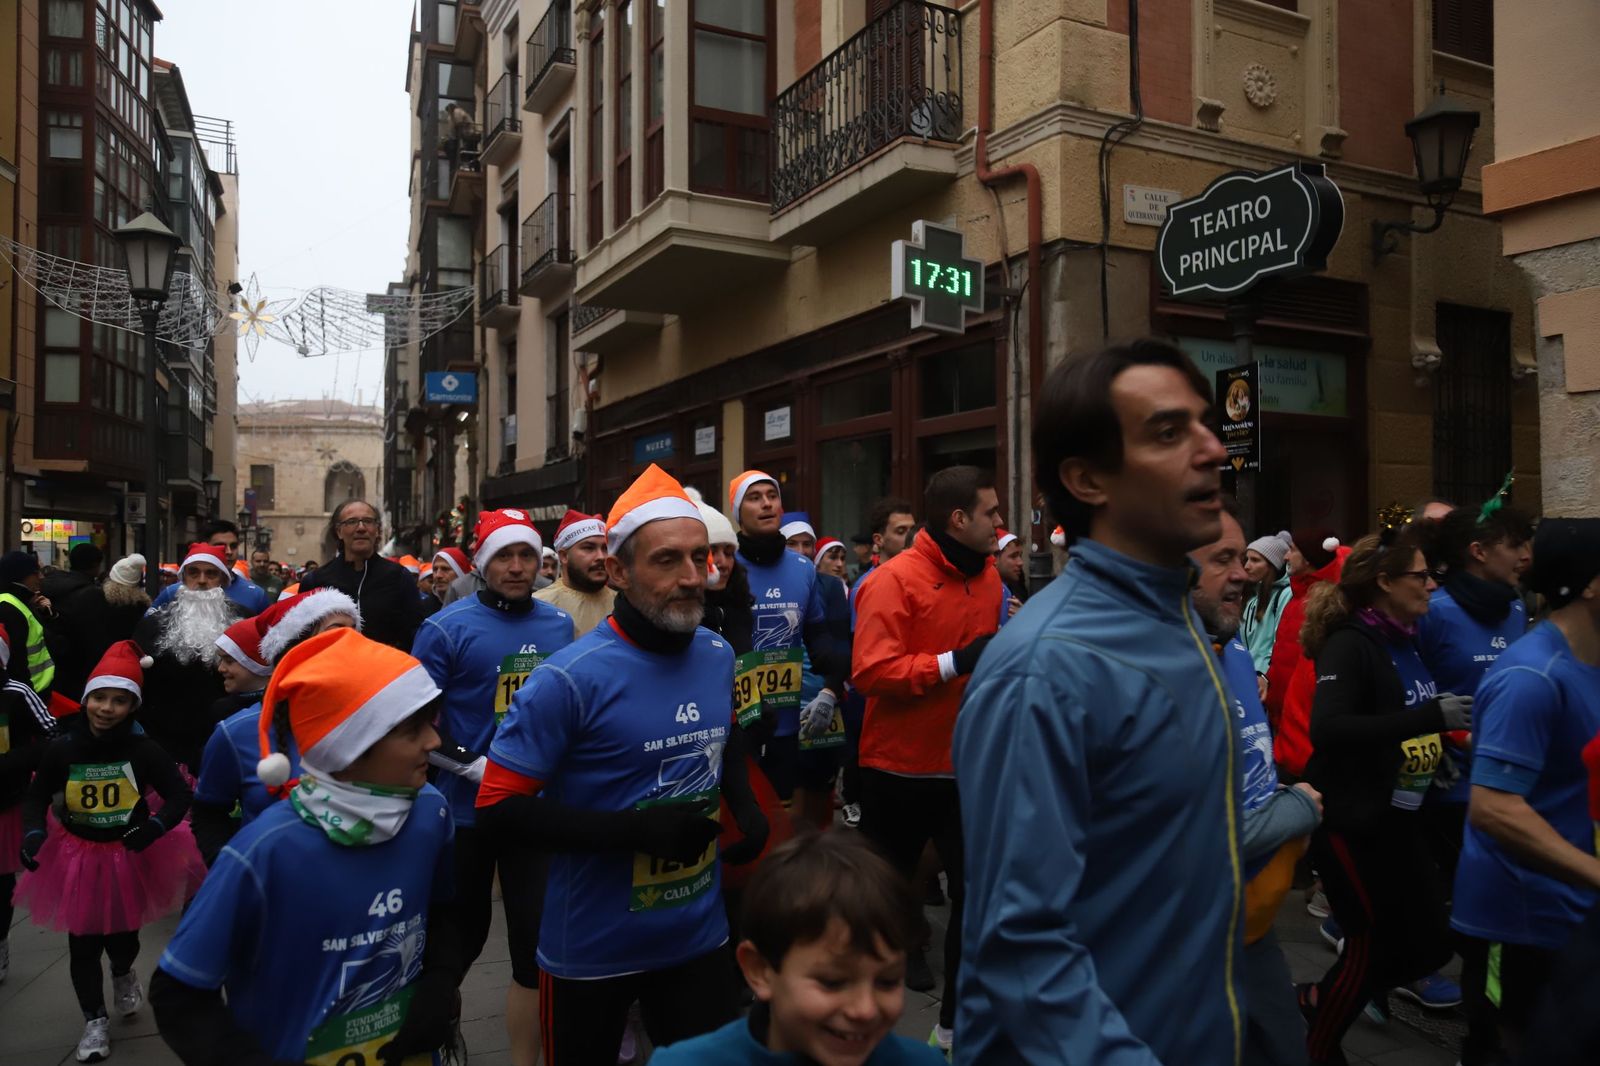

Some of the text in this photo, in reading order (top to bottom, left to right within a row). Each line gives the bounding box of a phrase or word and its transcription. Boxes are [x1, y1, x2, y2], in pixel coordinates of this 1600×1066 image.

[1145, 193, 1169, 202] CALLE
[1150, 203, 1160, 211] DE
[1190, 195, 1271, 238] TEATRO
[1180, 228, 1288, 277] PRINCIPAL
[911, 259, 971, 296] 17:31
[1277, 356, 1307, 370] salud
[766, 587, 781, 598] 46
[519, 644, 537, 654] 46
[1491, 636, 1507, 649] 46
[757, 668, 792, 694] 794
[675, 702, 700, 724] 46
[644, 739, 664, 752] SAN
[665, 729, 709, 748] SILVESTRE
[81, 783, 120, 809] 80
[368, 888, 403, 917] 46
[663, 885, 691, 901] CAJA
[322, 938, 348, 951] SAN
[345, 1023, 372, 1039] CAJA
[373, 1012, 401, 1031] RURAL
